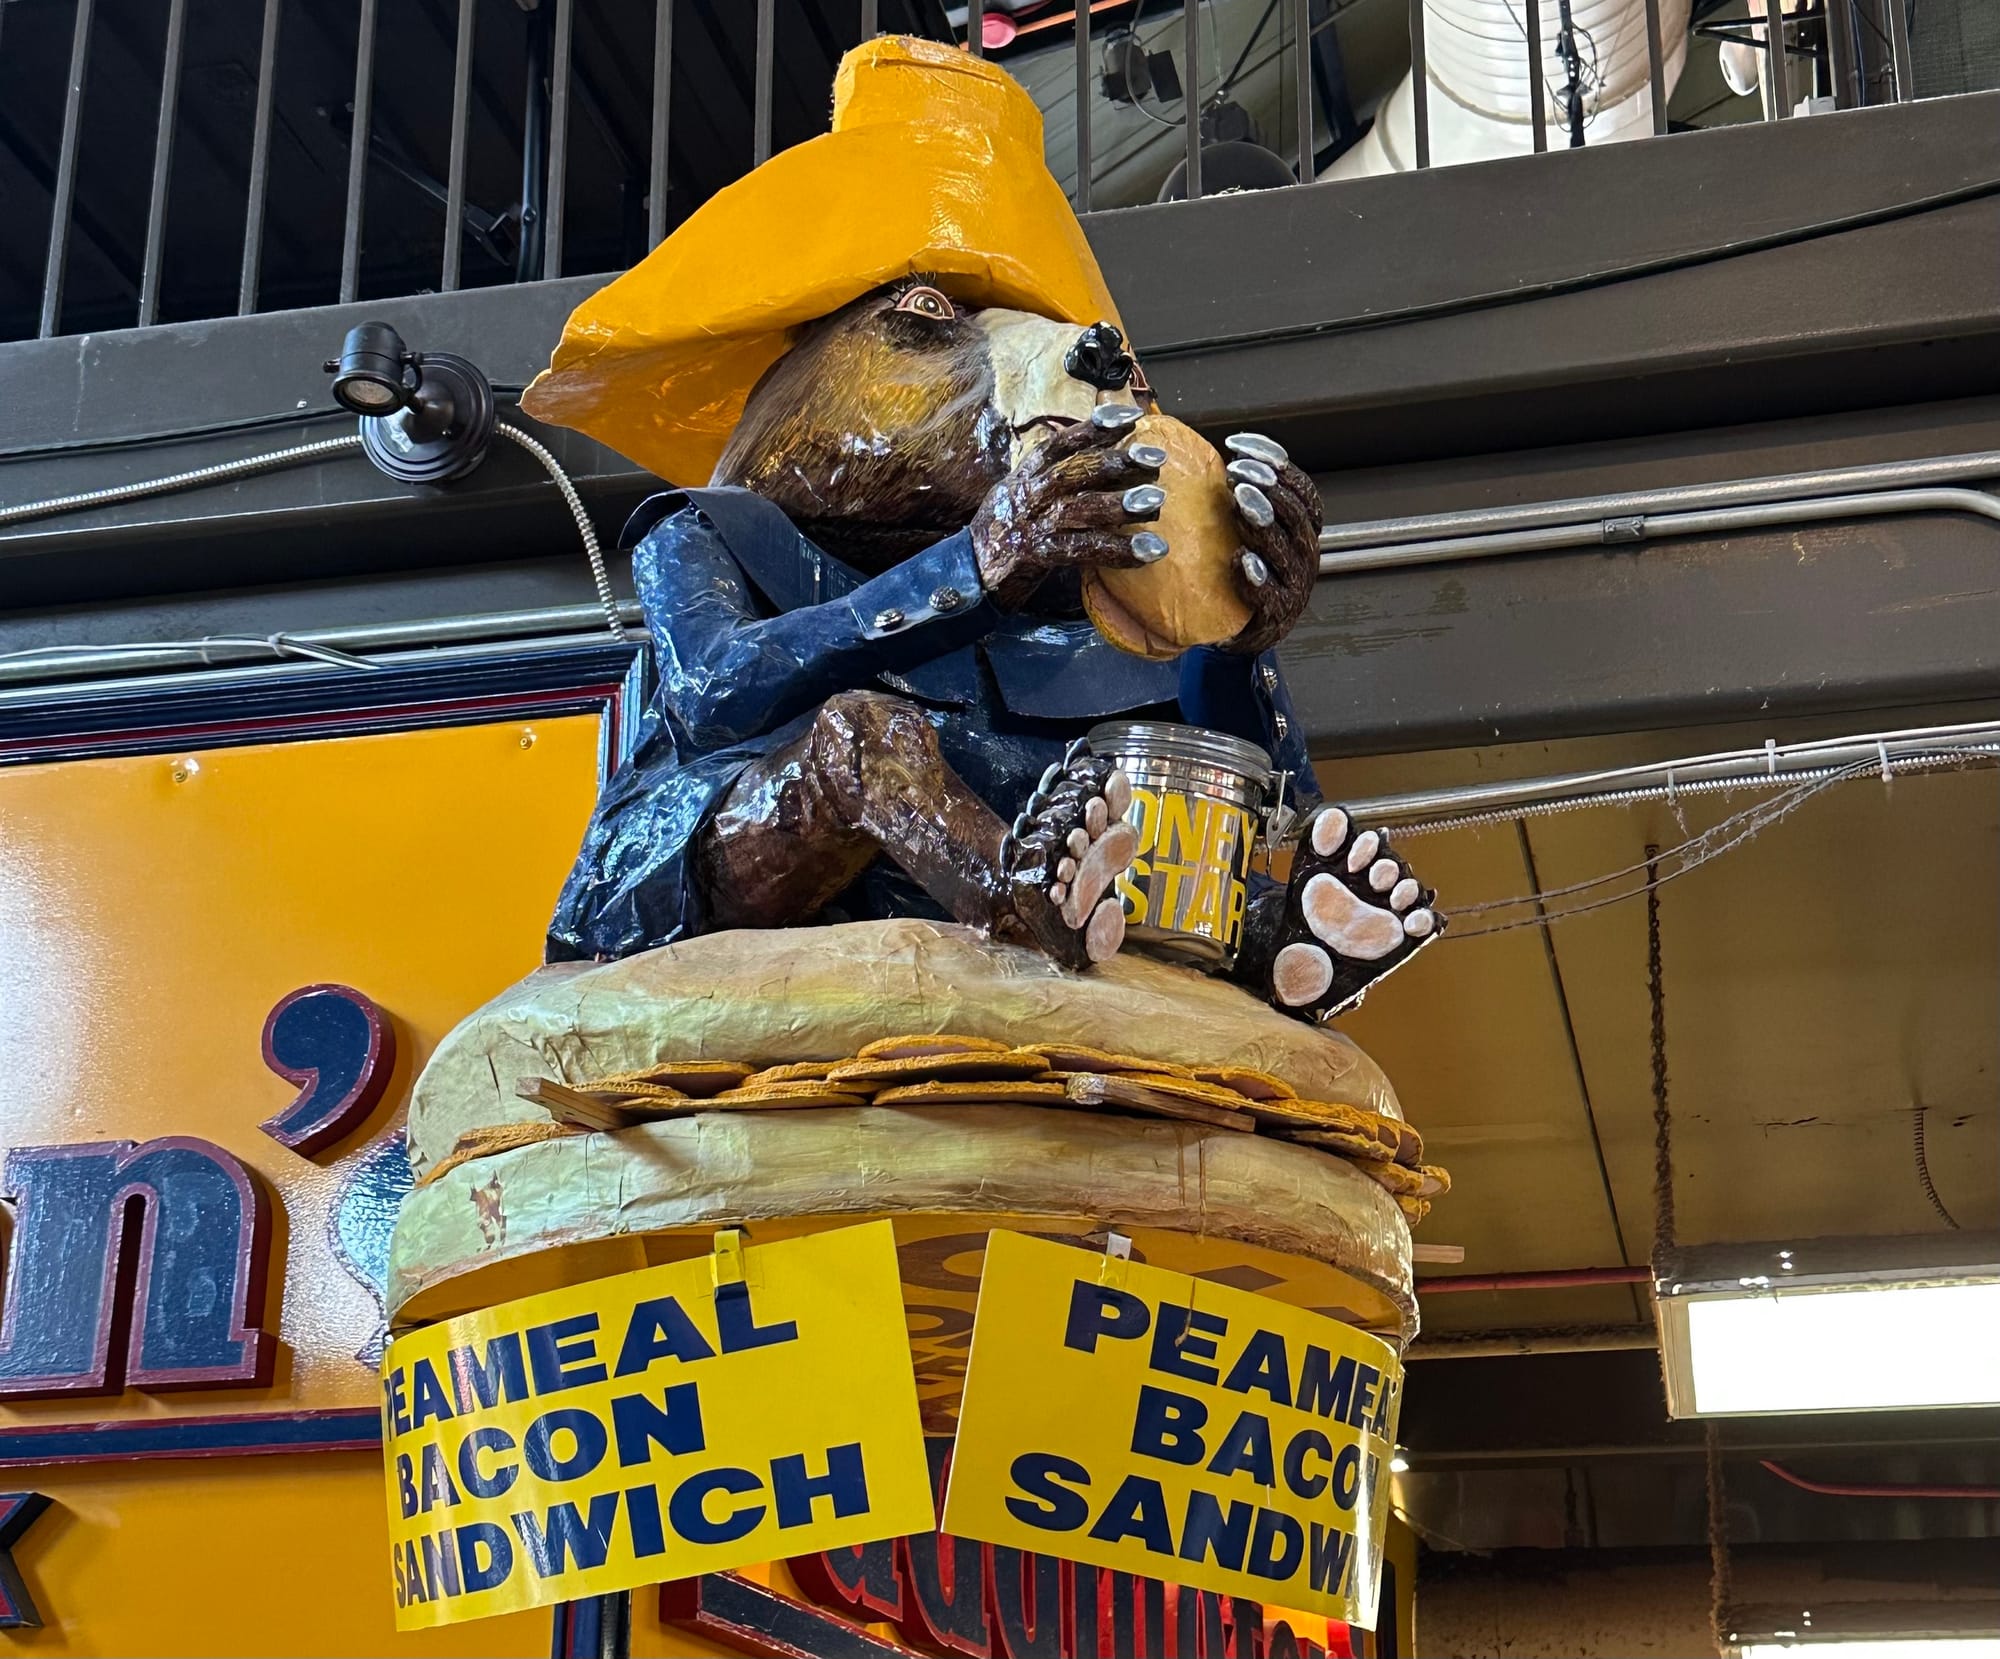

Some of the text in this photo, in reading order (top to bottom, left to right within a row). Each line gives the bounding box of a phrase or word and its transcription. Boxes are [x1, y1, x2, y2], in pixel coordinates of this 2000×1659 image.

[1122, 789, 1258, 879] ONEY
[1063, 1279, 1390, 1442] PEAMEA
[393, 1442, 870, 1608] SANDWICH
[396, 1382, 706, 1520] BACON
